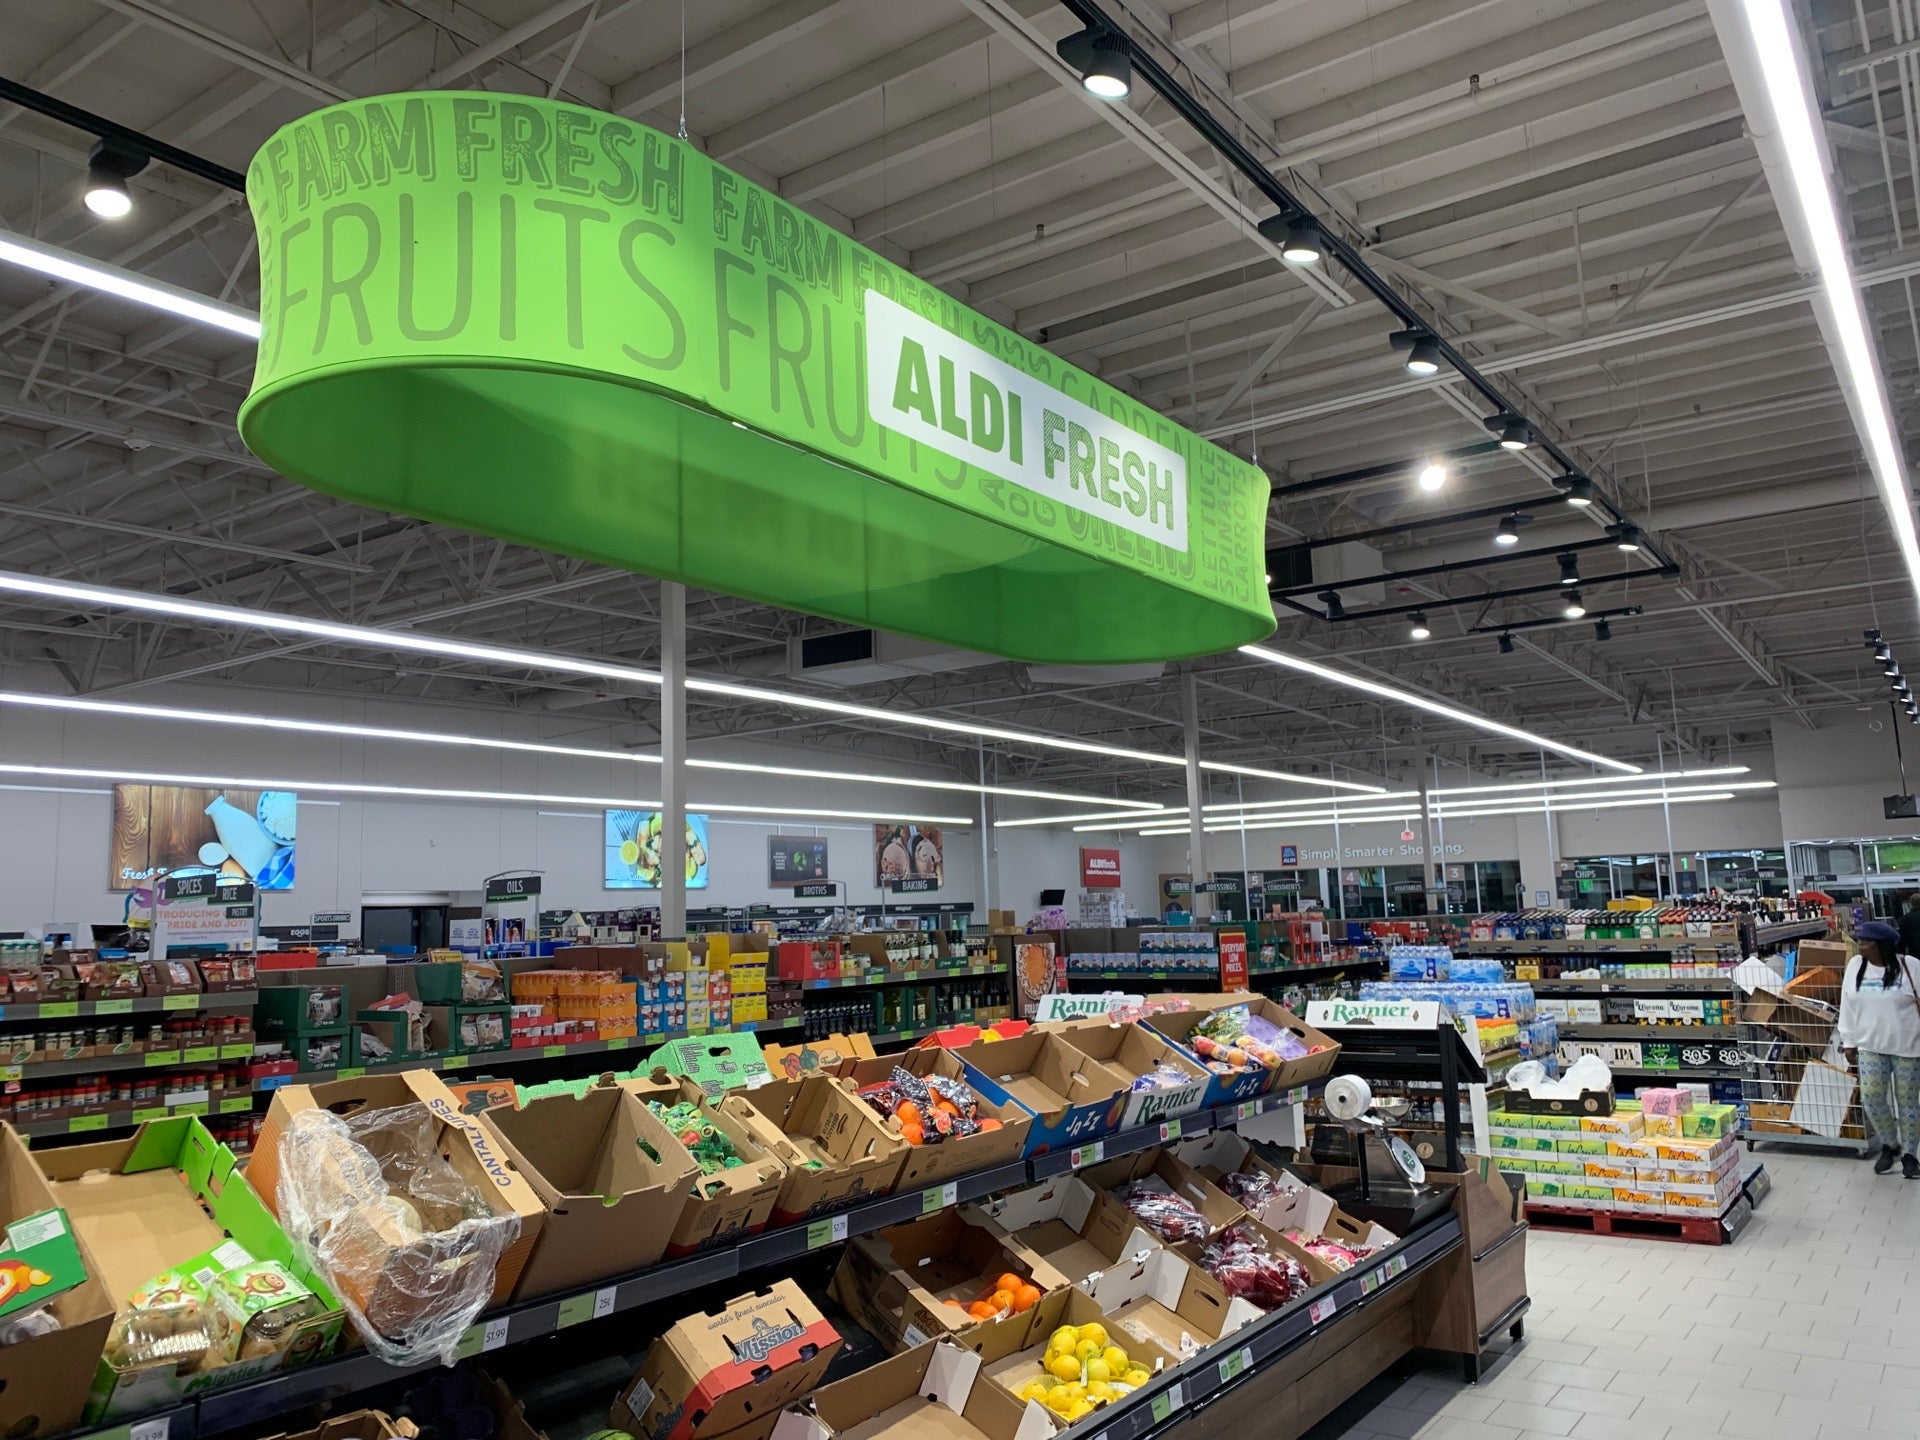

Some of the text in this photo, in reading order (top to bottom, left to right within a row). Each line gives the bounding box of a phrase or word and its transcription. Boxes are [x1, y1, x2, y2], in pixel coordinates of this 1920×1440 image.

[266, 98, 684, 224] FARM FRESH
[711, 165, 843, 304] FARM
[268, 190, 687, 376] FRUITS
[892, 335, 1024, 467] ALDI
[1043, 407, 1175, 531] FRESH
[1200, 445, 1218, 590] LETTUCE
[1217, 452, 1235, 597] SPINACH
[1232, 464, 1250, 602] CARROTS
[1301, 849, 1339, 861] Simply
[1344, 846, 1394, 858] Smarter
[1680, 858, 1688, 870] 1
[1252, 876, 1259, 886] 5
[1346, 872, 1354, 882] 4
[1451, 868, 1459, 879] 3
[1575, 870, 1596, 879] CHIPS
[177, 879, 202, 896] SPICES
[506, 880, 524, 893] OILS
[803, 886, 827, 896] BROTHS
[902, 880, 928, 891] BAKING
[1206, 883, 1237, 891] DRESSINGS
[1268, 883, 1301, 891] CONDIMENTS
[1394, 884, 1422, 892] VEGETABLES
[222, 887, 237, 901] RICE
[146, 908, 220, 920] ITRODUCING
[167, 918, 247, 930] PRIDE AND JOY!
[290, 929, 310, 938] EGGS
[1333, 1003, 1410, 1021] Rainier
[1638, 1001, 1664, 1011] Corona
[1671, 1001, 1699, 1011] Corona
[1614, 1045, 1635, 1060] IPA
[1682, 1048, 1711, 1064] 805
[1234, 1077, 1260, 1098] JAZZ
[1135, 1085, 1201, 1126] Rainier
[1066, 1110, 1102, 1137] JAZZ
[430, 1098, 511, 1187] CANTALUPES
[707, 1294, 786, 1330] world's finest avocados
[485, 1327, 506, 1343] $1.99
[733, 1321, 806, 1365] Mission
[184, 1362, 264, 1393] Mighties
